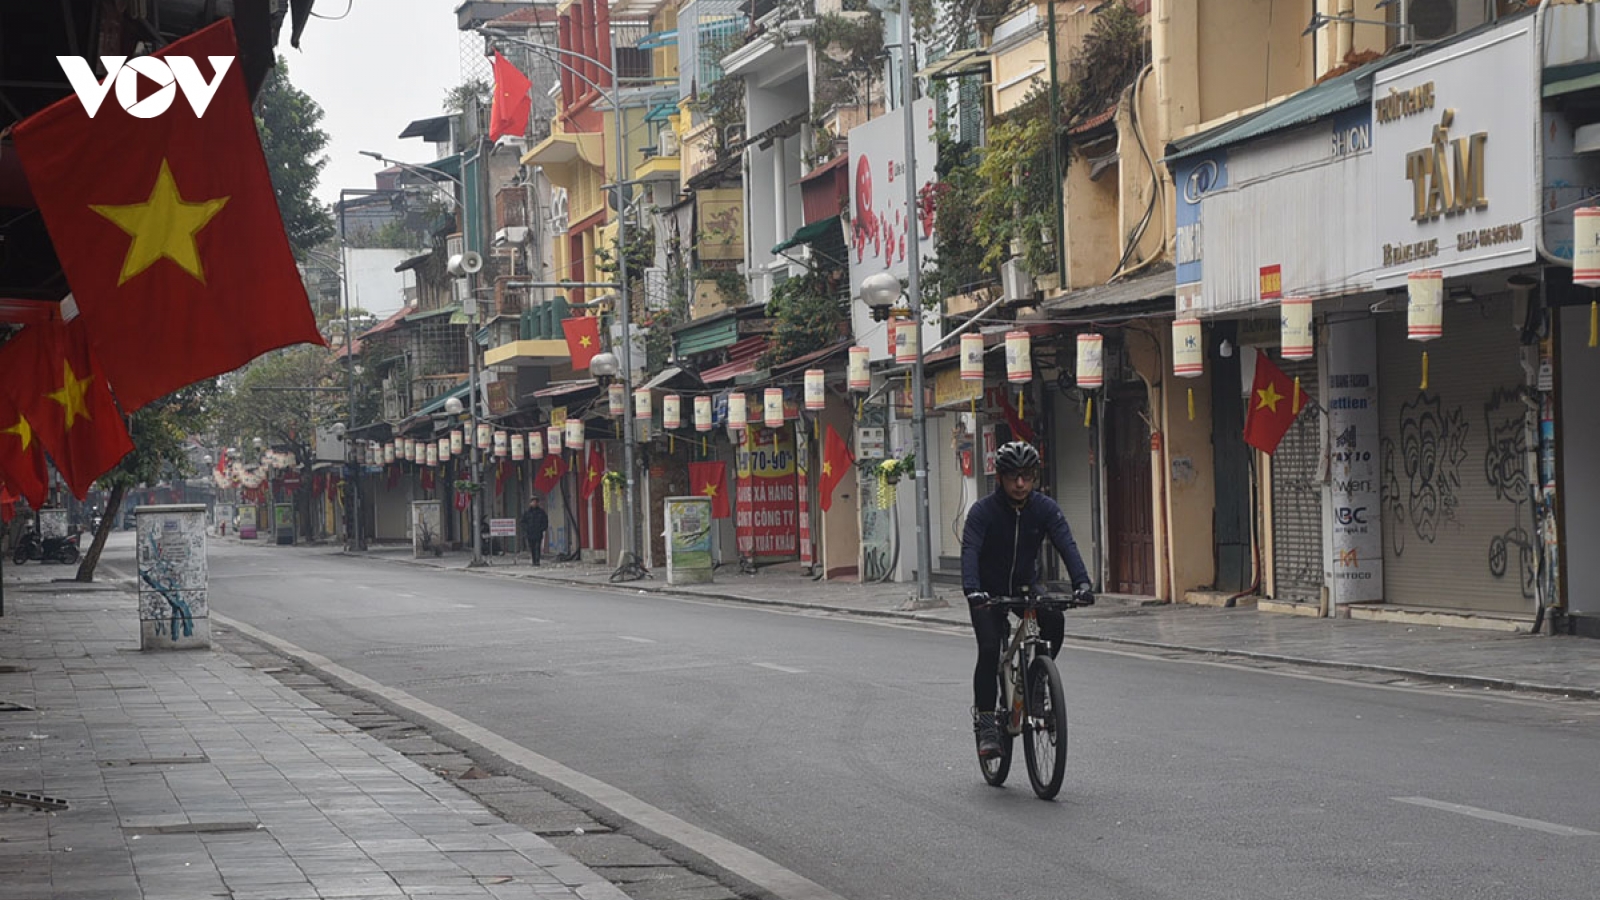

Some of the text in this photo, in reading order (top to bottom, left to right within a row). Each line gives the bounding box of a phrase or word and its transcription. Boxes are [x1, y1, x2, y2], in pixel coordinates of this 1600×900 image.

[1405, 108, 1488, 225] TẤM
[754, 507, 781, 527] CÔNG
[783, 509, 794, 526] TY
